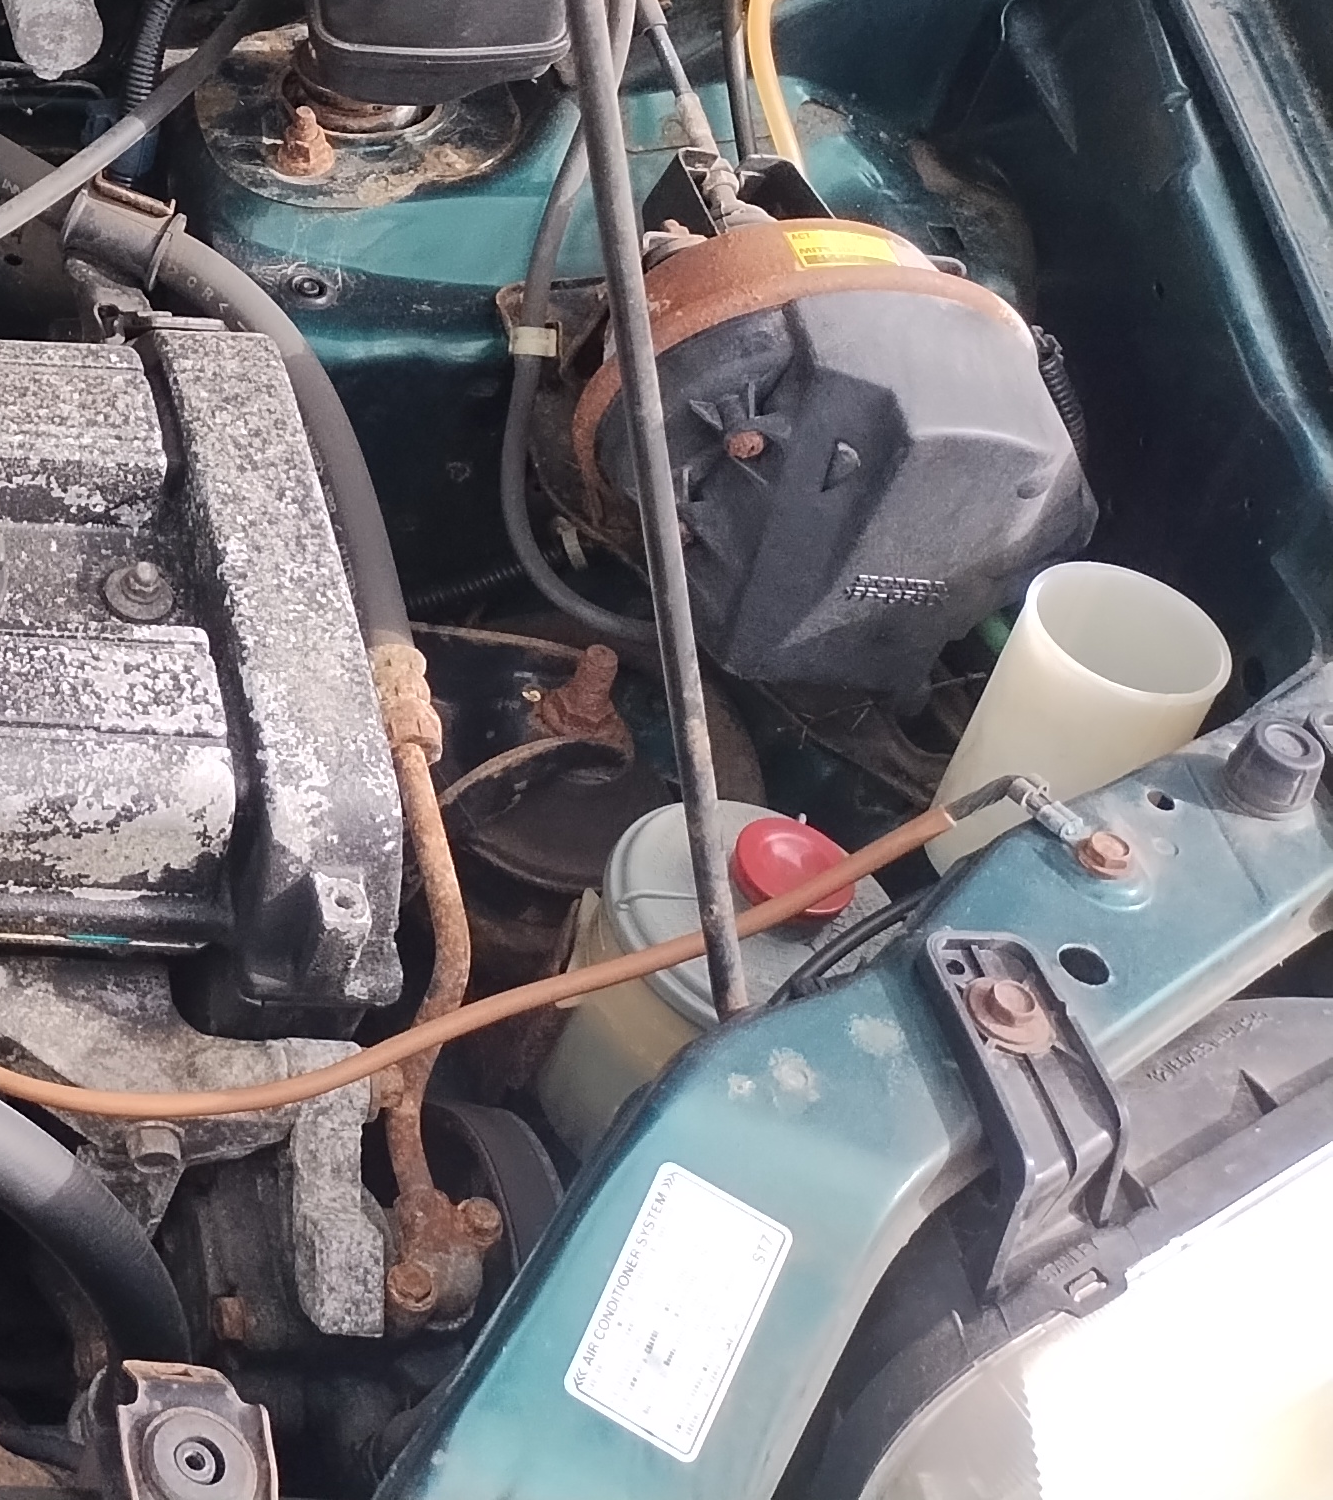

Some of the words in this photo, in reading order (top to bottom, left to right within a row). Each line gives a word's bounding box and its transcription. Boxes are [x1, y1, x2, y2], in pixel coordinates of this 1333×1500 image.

[582, 1341, 600, 1367] AIR
[593, 1248, 641, 1341] CONDITIONER
[635, 1192, 667, 1247] SYSTEM
